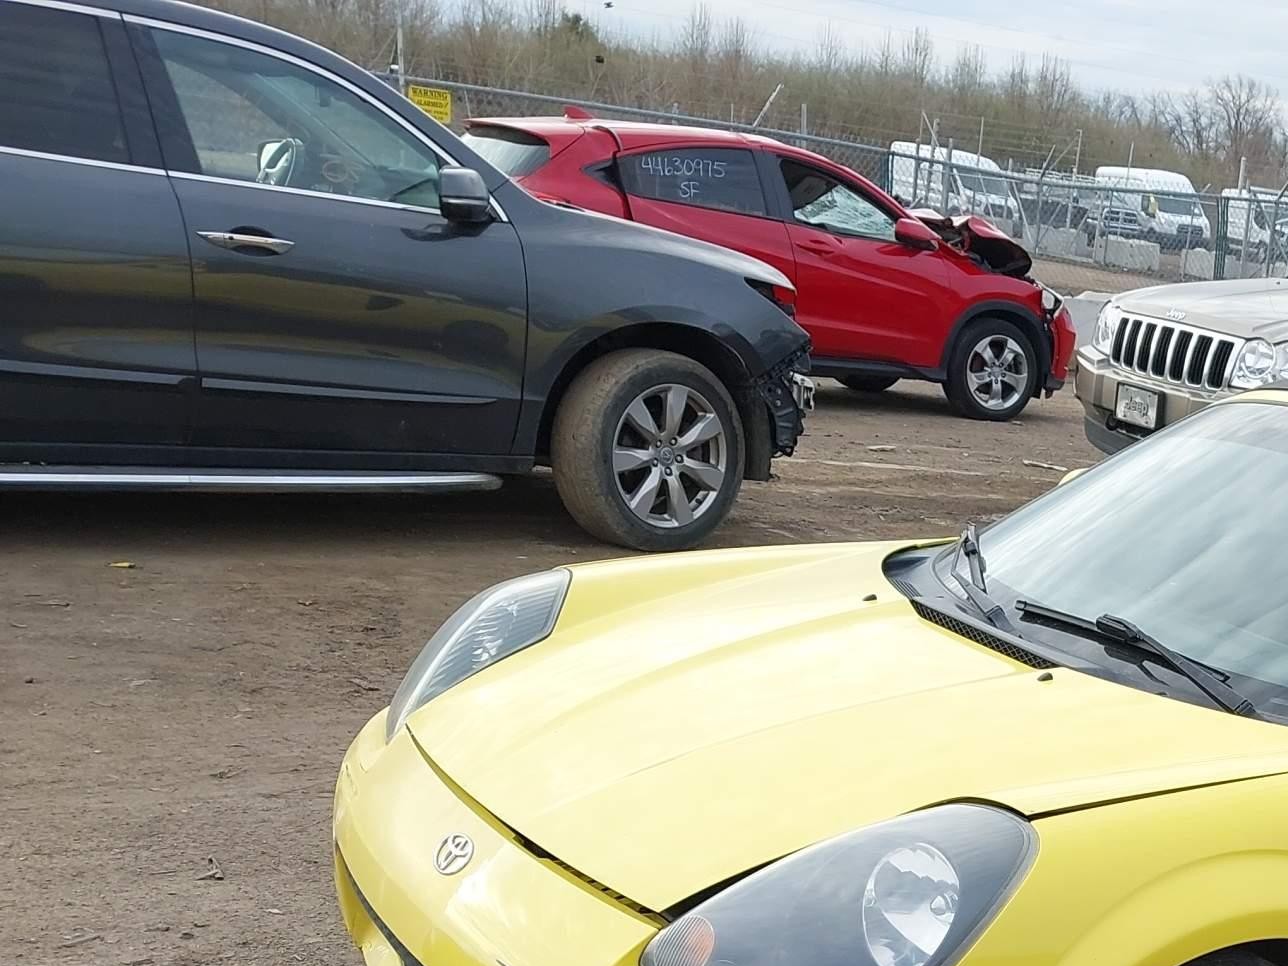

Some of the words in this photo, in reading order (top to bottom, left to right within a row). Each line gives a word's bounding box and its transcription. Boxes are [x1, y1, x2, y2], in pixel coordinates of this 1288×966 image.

[411, 87, 448, 99] WARNING
[641, 155, 728, 178] 44630975
[680, 181, 700, 198] SF
